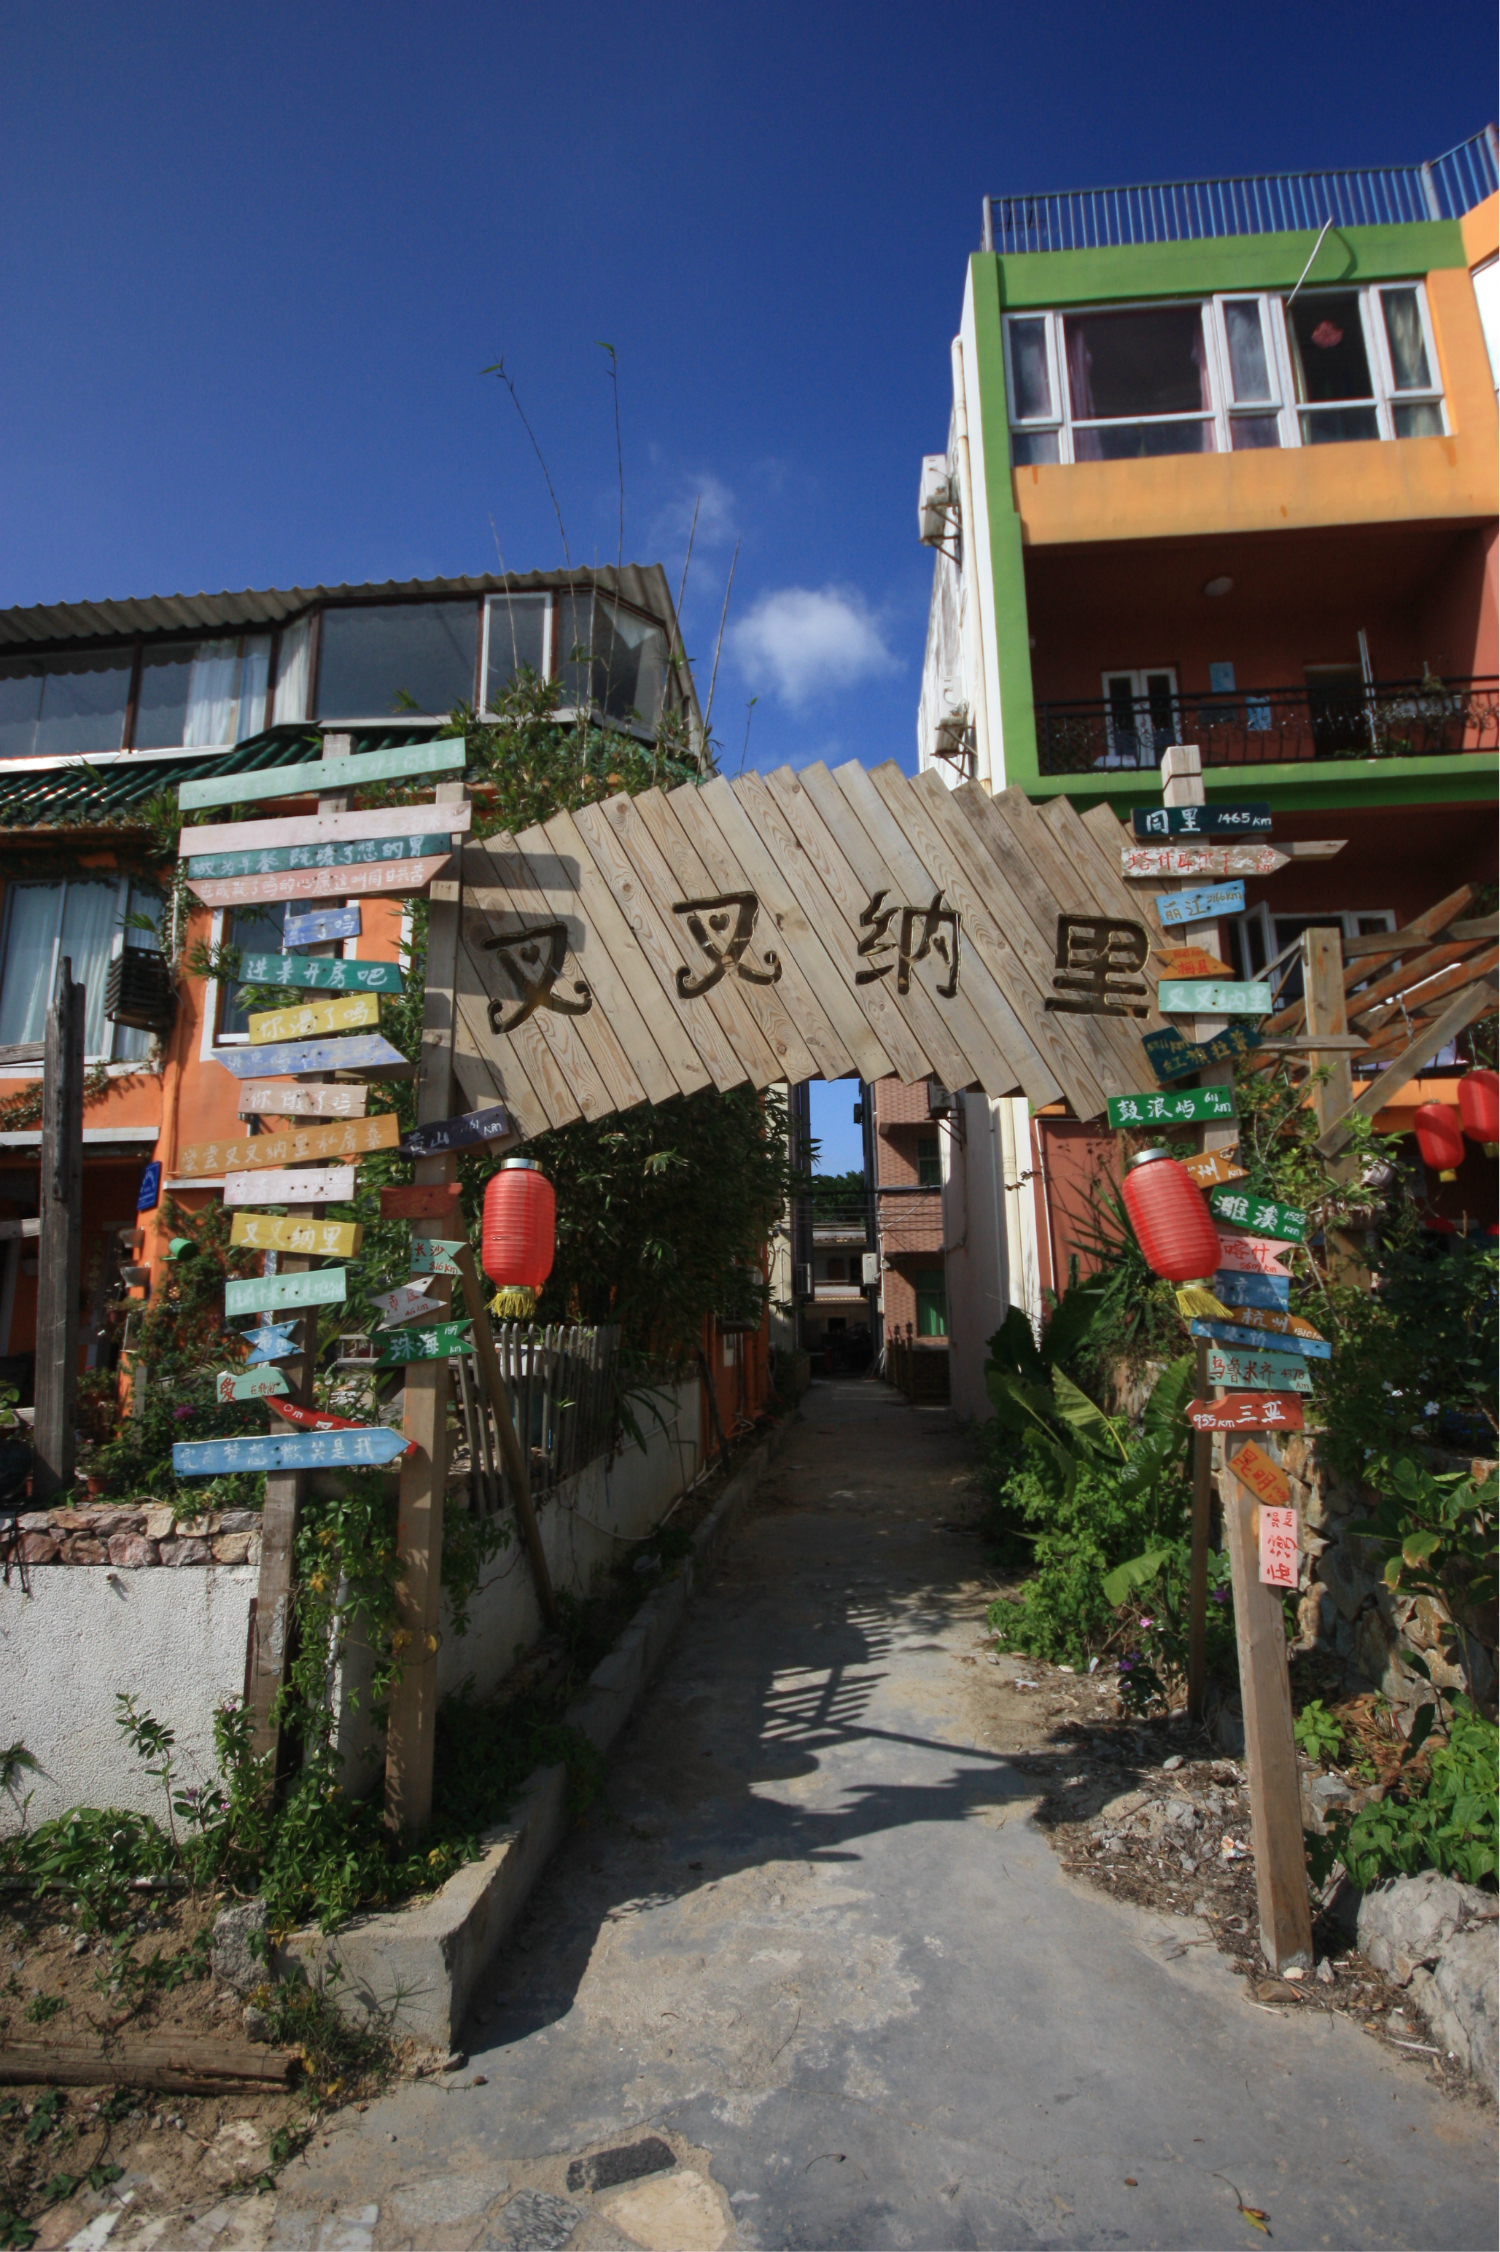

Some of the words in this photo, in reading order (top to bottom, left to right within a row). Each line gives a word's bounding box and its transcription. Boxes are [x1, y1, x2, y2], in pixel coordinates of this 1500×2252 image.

[1146, 807, 1201, 834] 同里
[1217, 812, 1251, 825] 1465
[1163, 899, 1208, 920] 丽江
[245, 959, 387, 991] 进来开房吧
[481, 887, 1152, 1036] 叉叉纳里
[1165, 984, 1269, 1011] 叉叉纳里
[259, 1000, 369, 1040] 你渴了吗
[1116, 1096, 1196, 1121] 鼓浪屿
[404, 1128, 451, 1155] 黄山
[1187, 1157, 1221, 1181] 州
[243, 1222, 342, 1255] 叉叉纳里
[414, 1242, 445, 1257] 长沙
[1224, 1240, 1271, 1263] 喀什
[1240, 1307, 1289, 1333] 杭州
[389, 1331, 439, 1361] 珠海
[1208, 1355, 1276, 1387] 乌鲁木齐
[1193, 1412, 1217, 1430] 935
[1236, 1400, 1286, 1424] 三亚
[1232, 1447, 1277, 1493] 昆明
